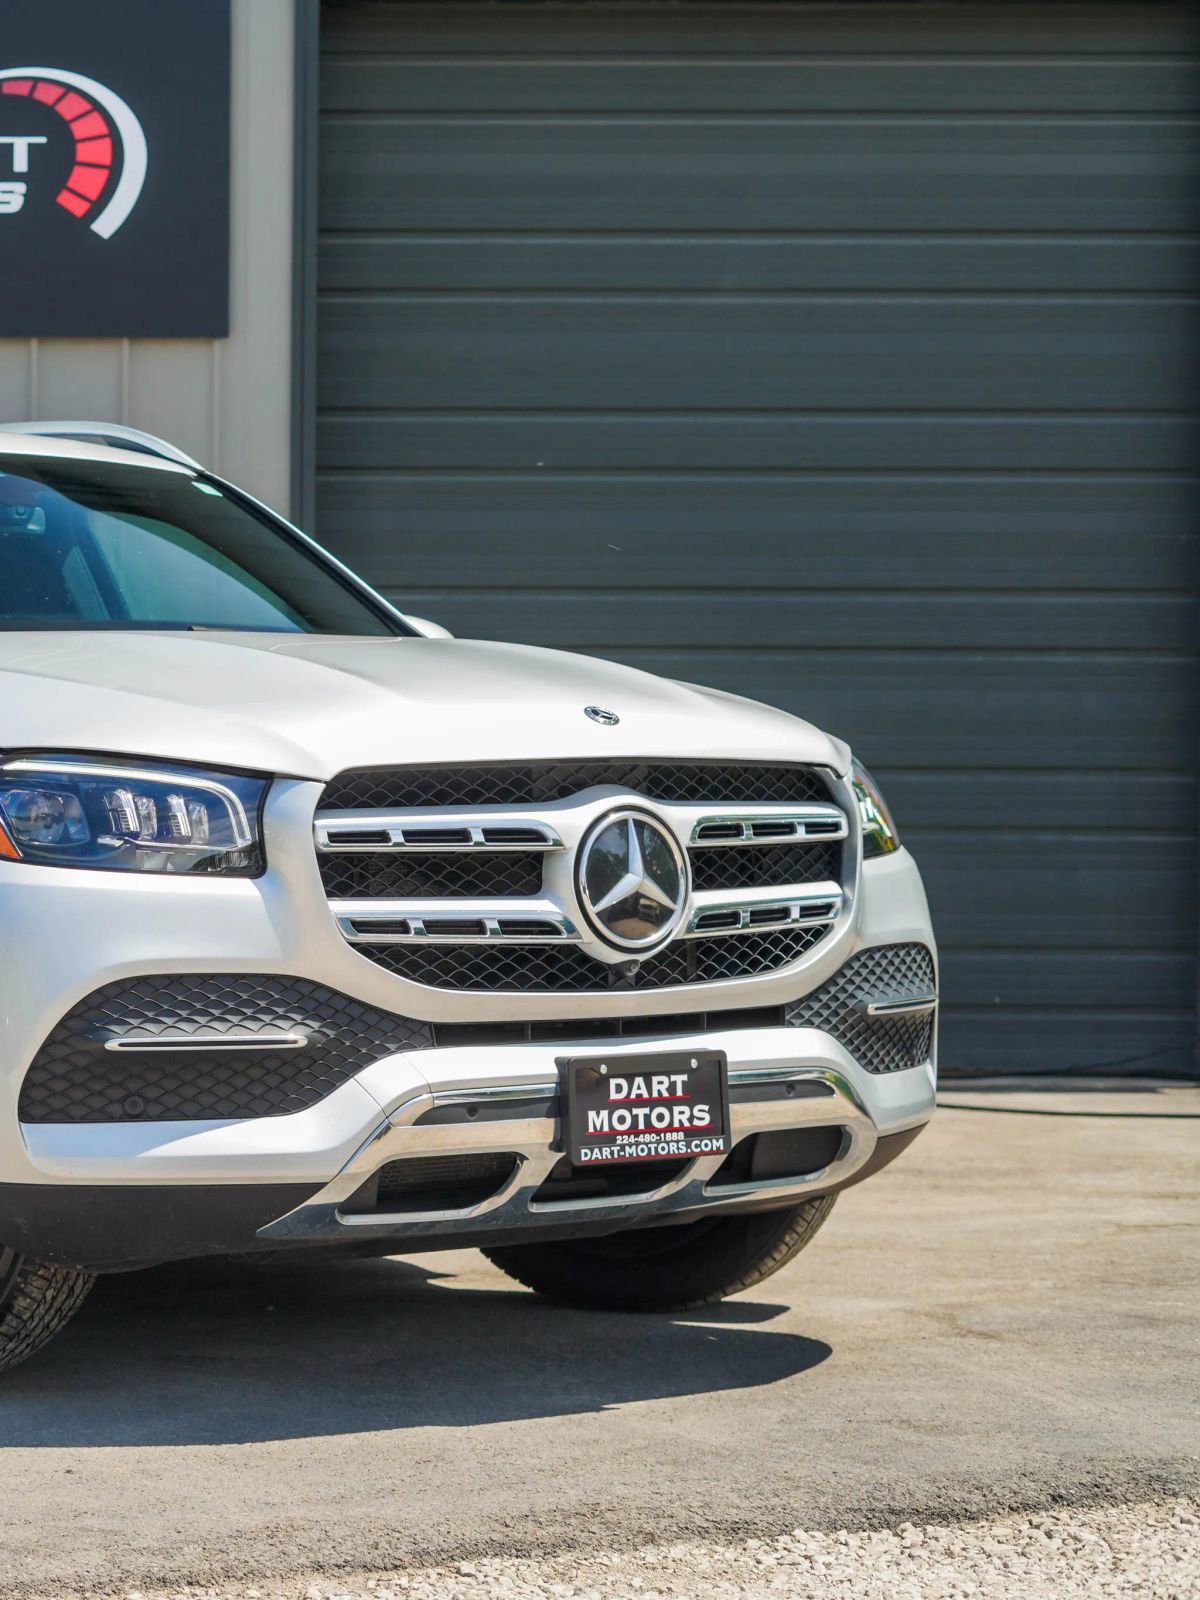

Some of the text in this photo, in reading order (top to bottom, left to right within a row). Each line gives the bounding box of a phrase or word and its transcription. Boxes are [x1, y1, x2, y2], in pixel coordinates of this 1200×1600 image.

[609, 1073, 689, 1100] DART
[587, 1104, 711, 1133] MOTORS
[581, 1138, 724, 1161] DART-MOTORS.COM
[616, 1131, 685, 1144] 224-480-1888
